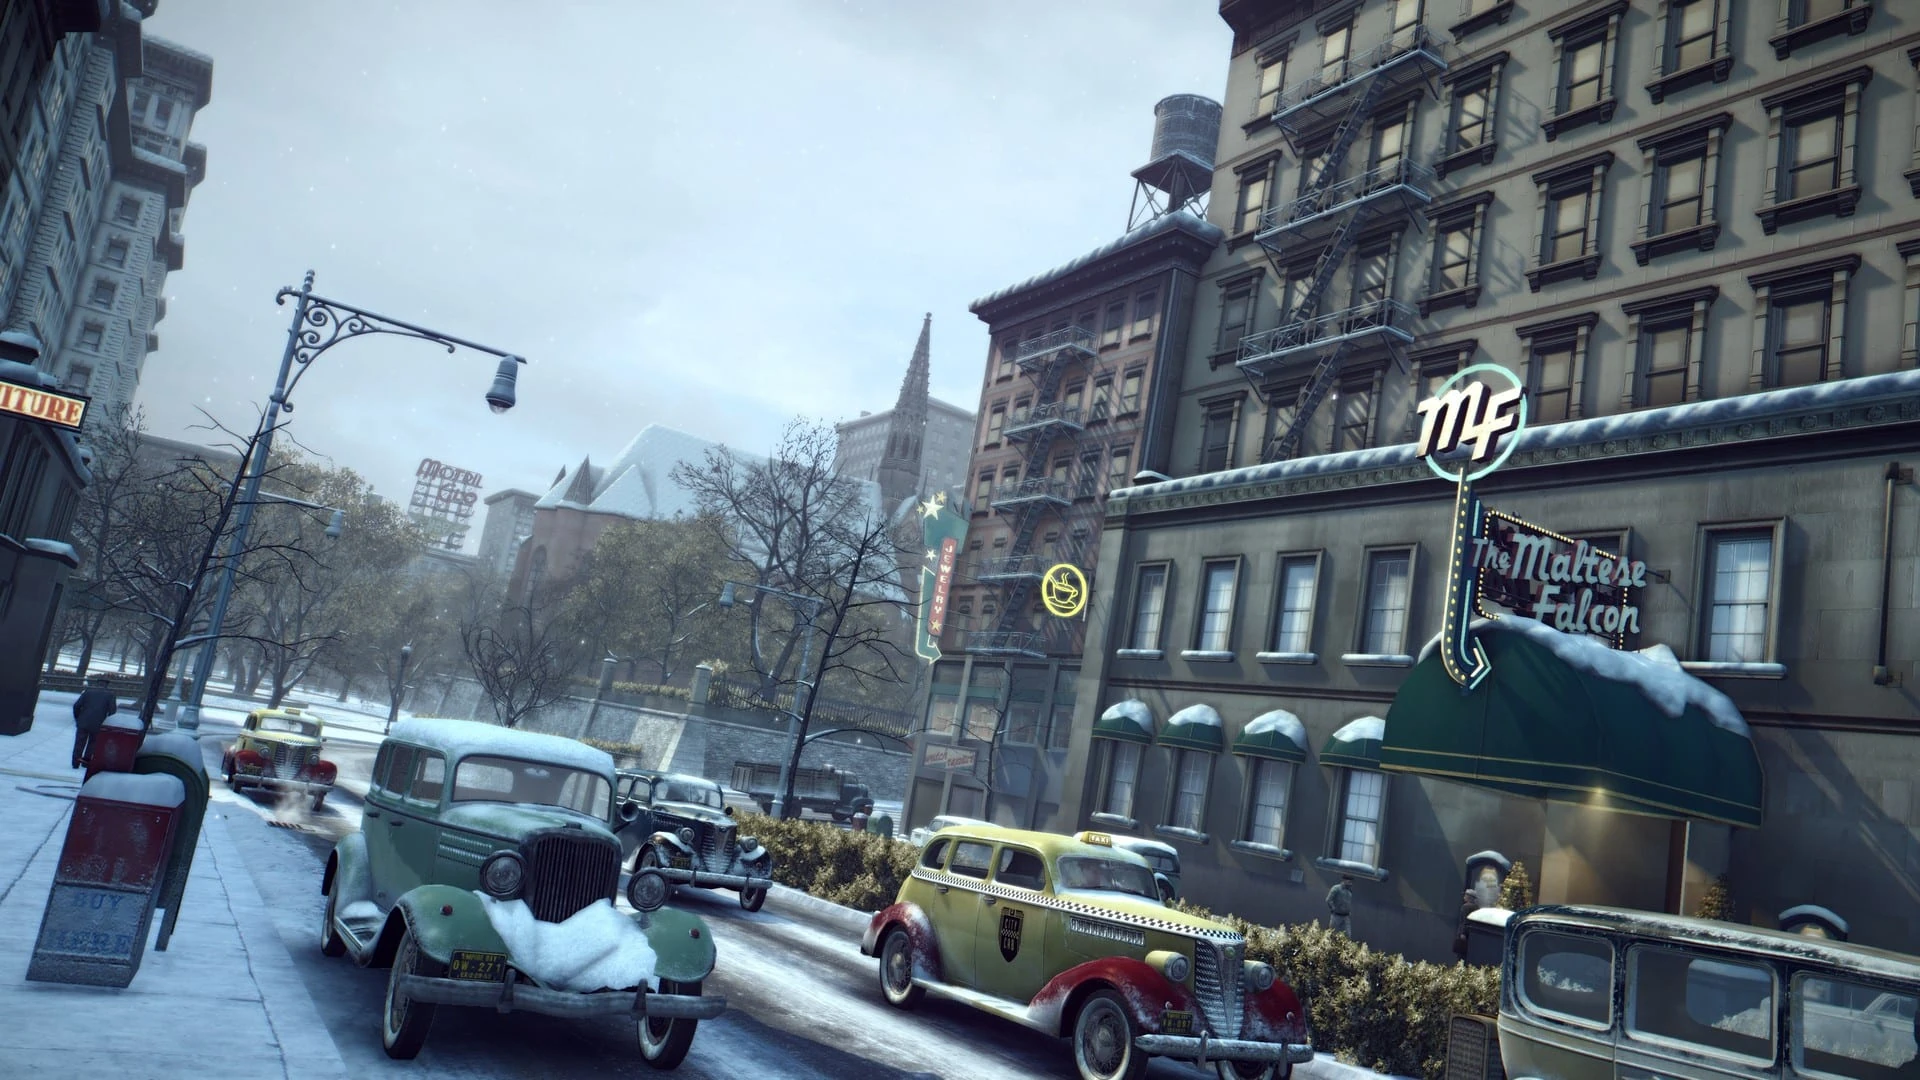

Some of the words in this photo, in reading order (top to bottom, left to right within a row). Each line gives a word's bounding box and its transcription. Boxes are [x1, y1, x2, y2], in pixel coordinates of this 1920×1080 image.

[0, 384, 80, 423] ITURE
[1416, 381, 1527, 463] MF
[934, 545, 953, 614] JEWELRY
[1472, 538, 1511, 573] The
[1511, 532, 1647, 588] Maltese
[1532, 584, 1640, 634] Falcon
[1090, 834, 1109, 844] TAXI
